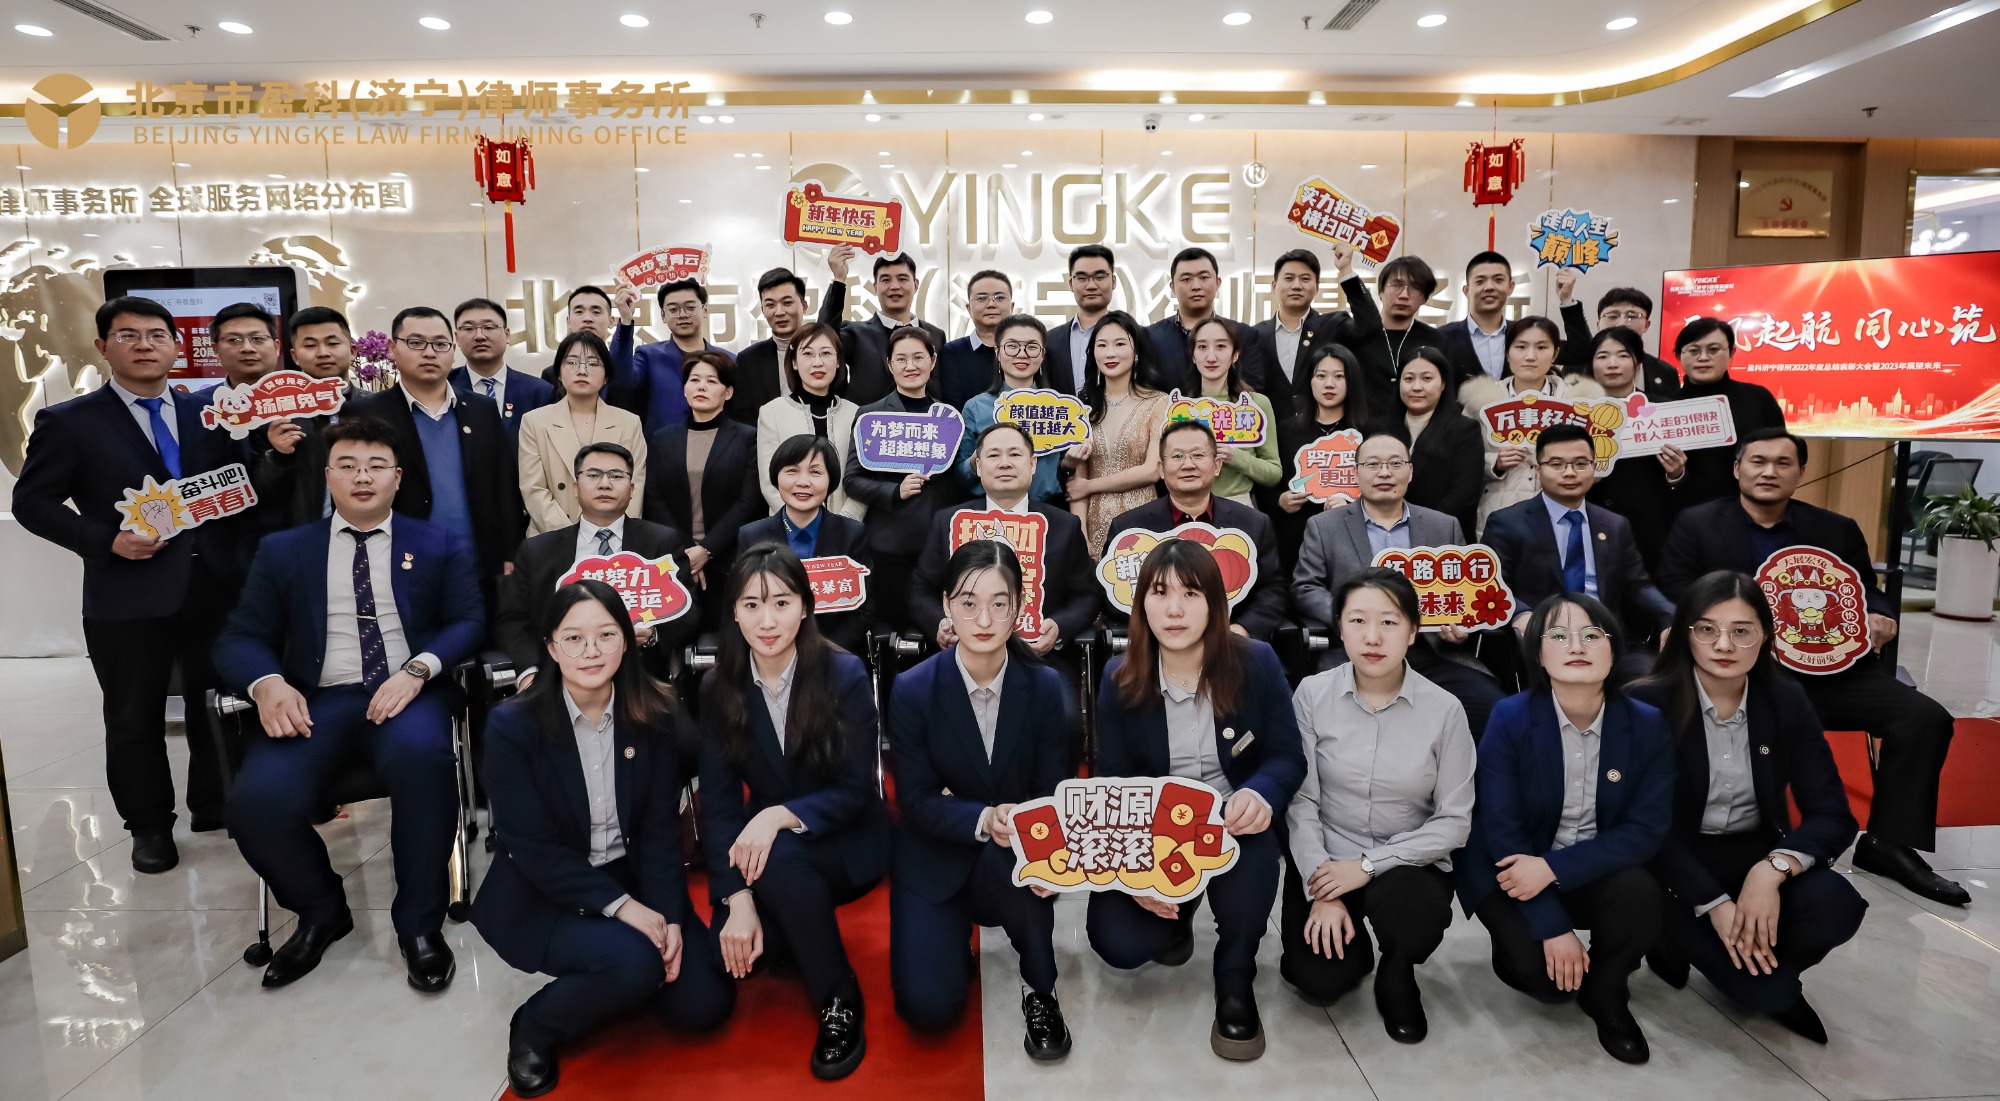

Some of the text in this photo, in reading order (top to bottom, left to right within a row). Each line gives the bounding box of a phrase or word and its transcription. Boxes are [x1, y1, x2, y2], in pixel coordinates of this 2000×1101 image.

[496, 148, 511, 188] 如意
[1487, 152, 1504, 191] 如意
[149, 181, 407, 213] 全球服务网络分布图
[890, 172, 1231, 244] YINGKE
[1300, 185, 1369, 228] 实力担当
[802, 224, 865, 237] HAPPY NEW YEAR
[807, 203, 876, 229] 新年快乐
[1301, 207, 1371, 251] 横扫四方
[1543, 211, 1610, 239] 走向人生
[1540, 232, 1601, 267] 巅峰
[254, 390, 338, 415] 扬眉兔气
[1009, 404, 1069, 421] 颜值越高
[870, 420, 939, 441] 为梦而来
[878, 439, 947, 460] 超越想象
[1841, 584, 1858, 634] 新年快乐
[1065, 785, 1153, 828] 财源
[1066, 823, 1154, 873] 滚滚
